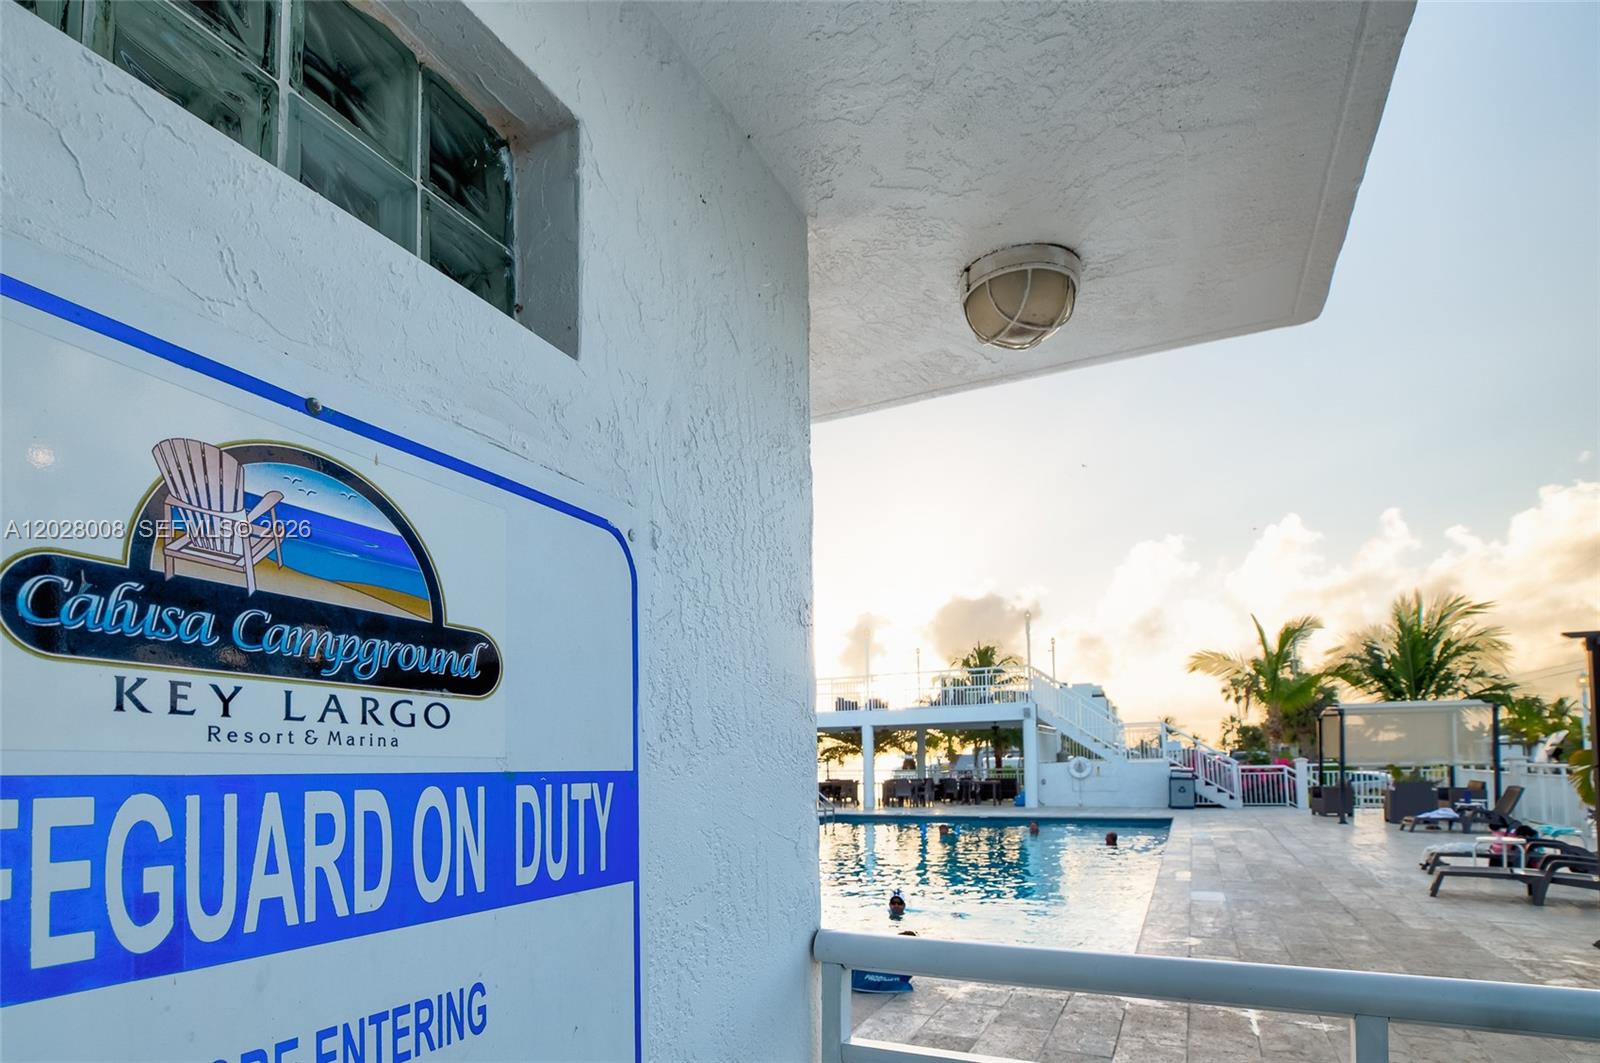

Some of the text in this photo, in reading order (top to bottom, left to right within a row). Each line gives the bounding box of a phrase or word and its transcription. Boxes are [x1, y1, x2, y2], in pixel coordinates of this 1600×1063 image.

[16, 574, 490, 681] Calusa Campground
[113, 675, 451, 729] KEY LARGO
[207, 724, 400, 748] Resort & Marina
[412, 784, 487, 904] ON
[515, 781, 615, 887] DUTY
[315, 981, 488, 1063] ENTERING
